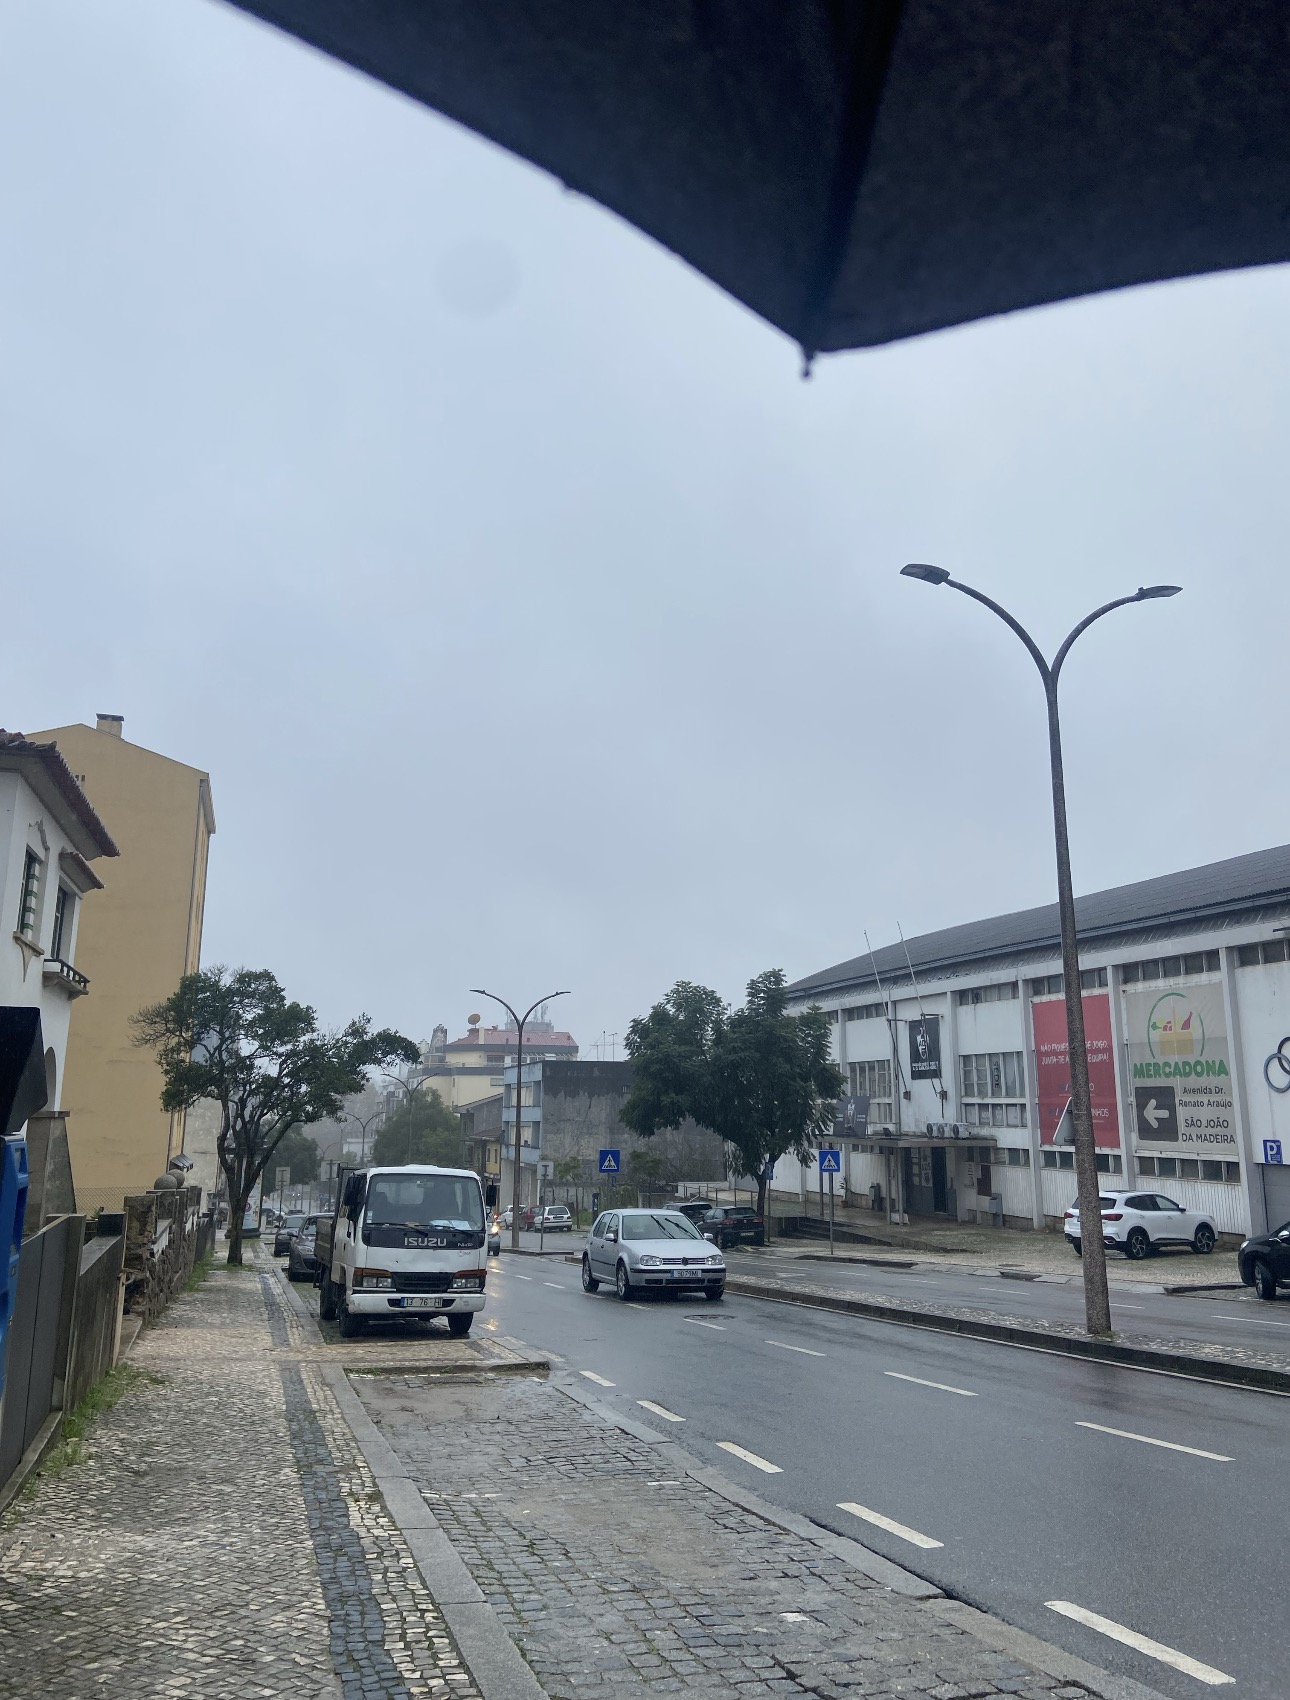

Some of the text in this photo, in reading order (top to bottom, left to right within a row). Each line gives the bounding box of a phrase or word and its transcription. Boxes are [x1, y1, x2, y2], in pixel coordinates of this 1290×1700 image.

[1133, 1060, 1229, 1079] MERCADONA
[1182, 1086, 1226, 1095] Avenida Dr.
[1179, 1098, 1232, 1109] Renato Araújo
[1184, 1116, 1229, 1129] SÃO JOÃO
[1181, 1132, 1236, 1144] DA MADEIRA
[404, 1237, 447, 1247] ISUZU
